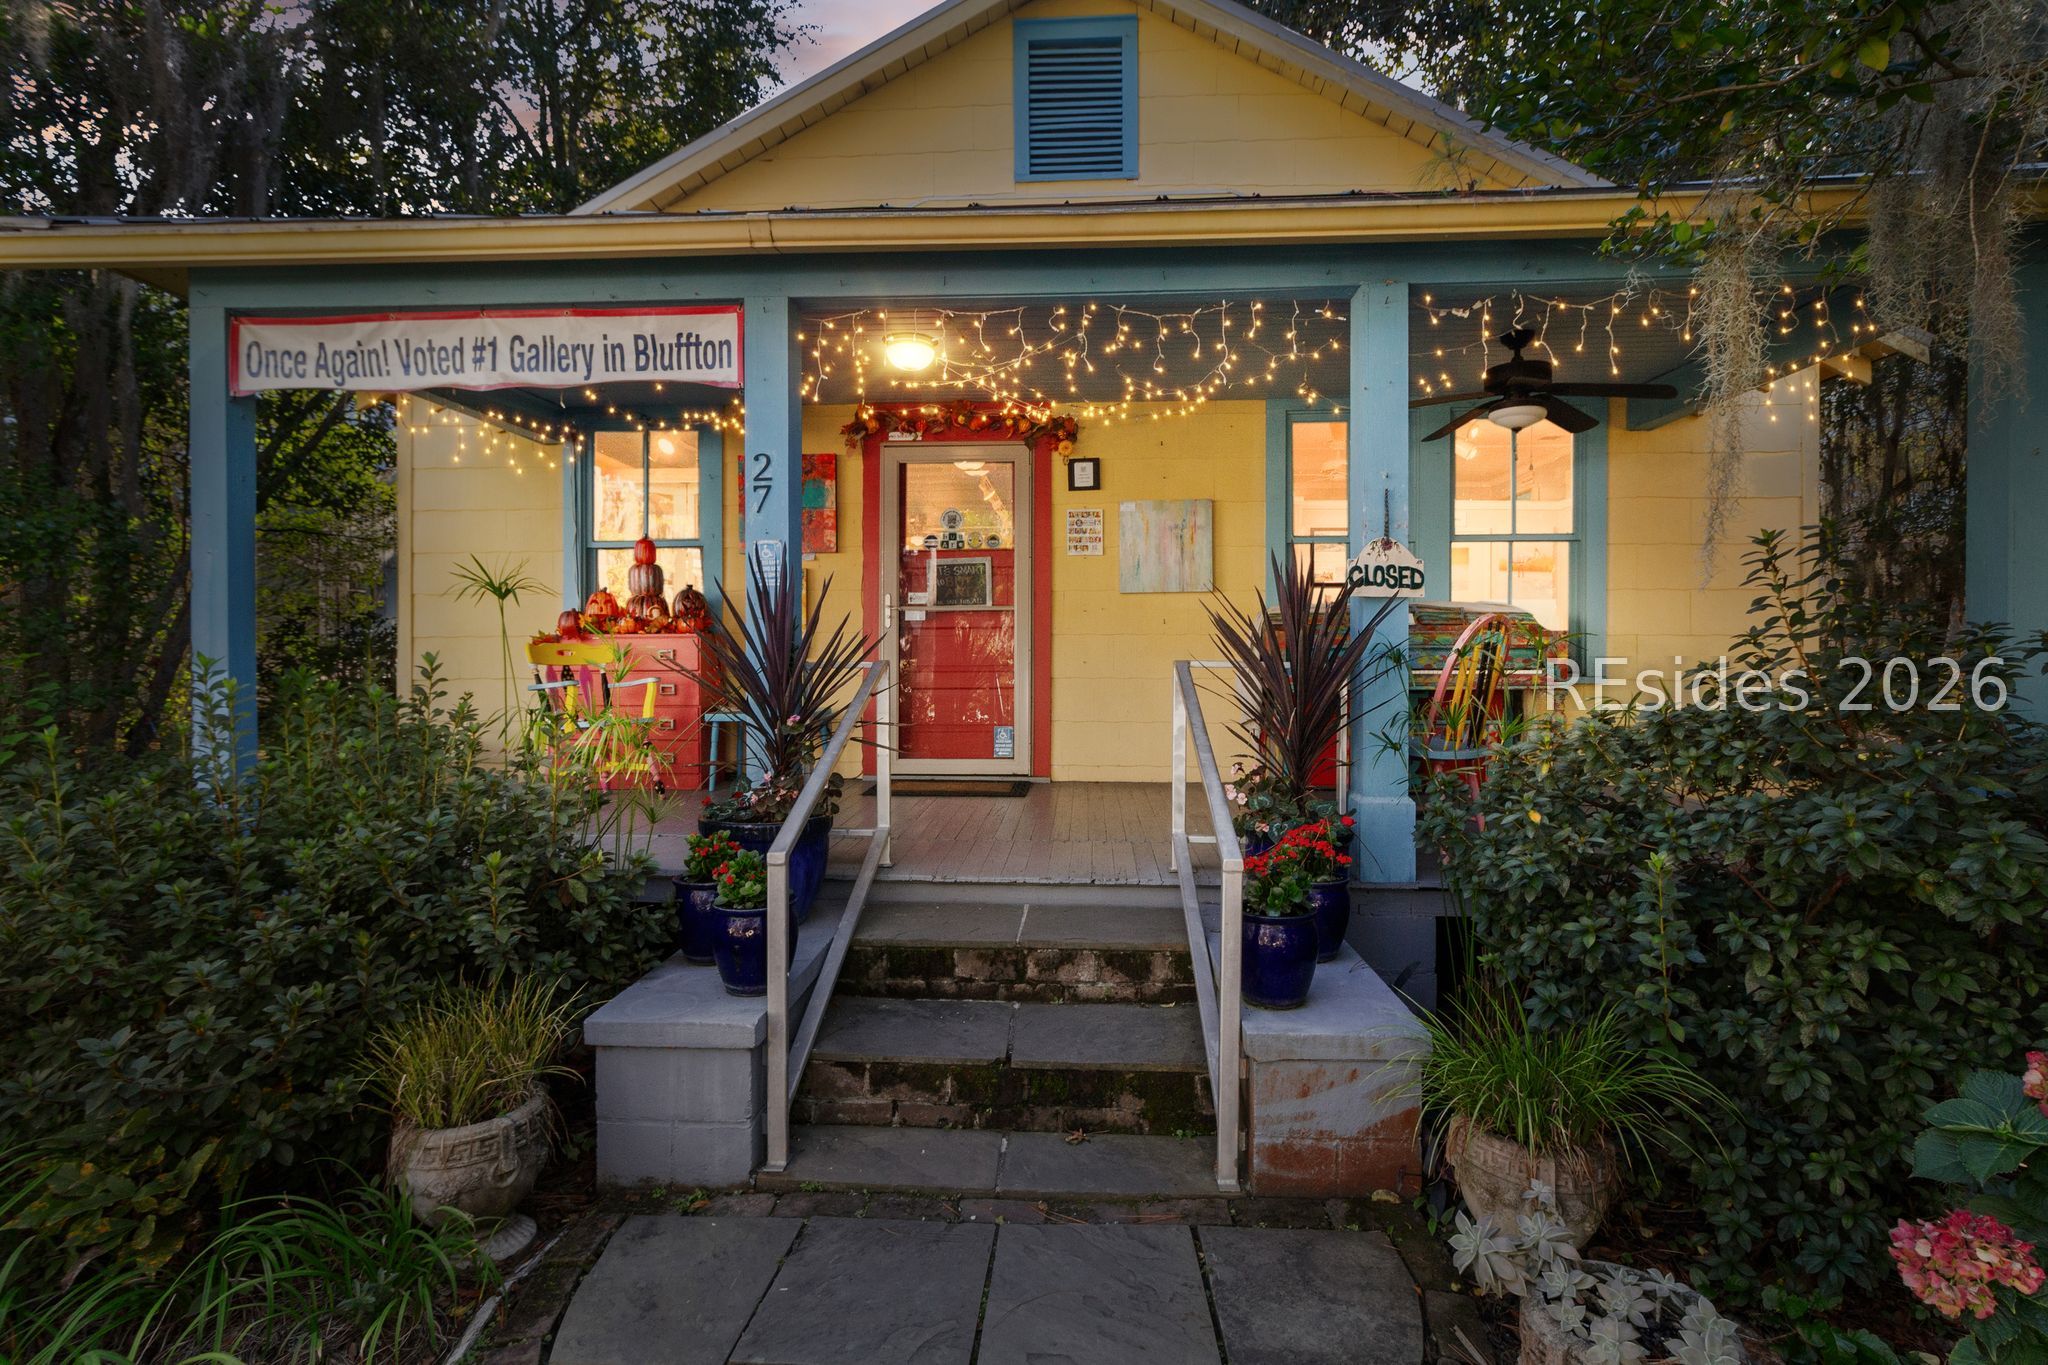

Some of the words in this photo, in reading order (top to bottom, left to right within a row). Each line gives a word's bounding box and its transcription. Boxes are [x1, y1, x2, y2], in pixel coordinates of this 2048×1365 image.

[245, 340, 307, 379] Once
[313, 339, 391, 387] Again!
[394, 336, 466, 377] Voted
[471, 335, 498, 373] #1
[509, 334, 595, 381] Gallery
[602, 333, 626, 373] in
[633, 331, 733, 372] Bluffton
[1348, 564, 1425, 590] CLOSED
